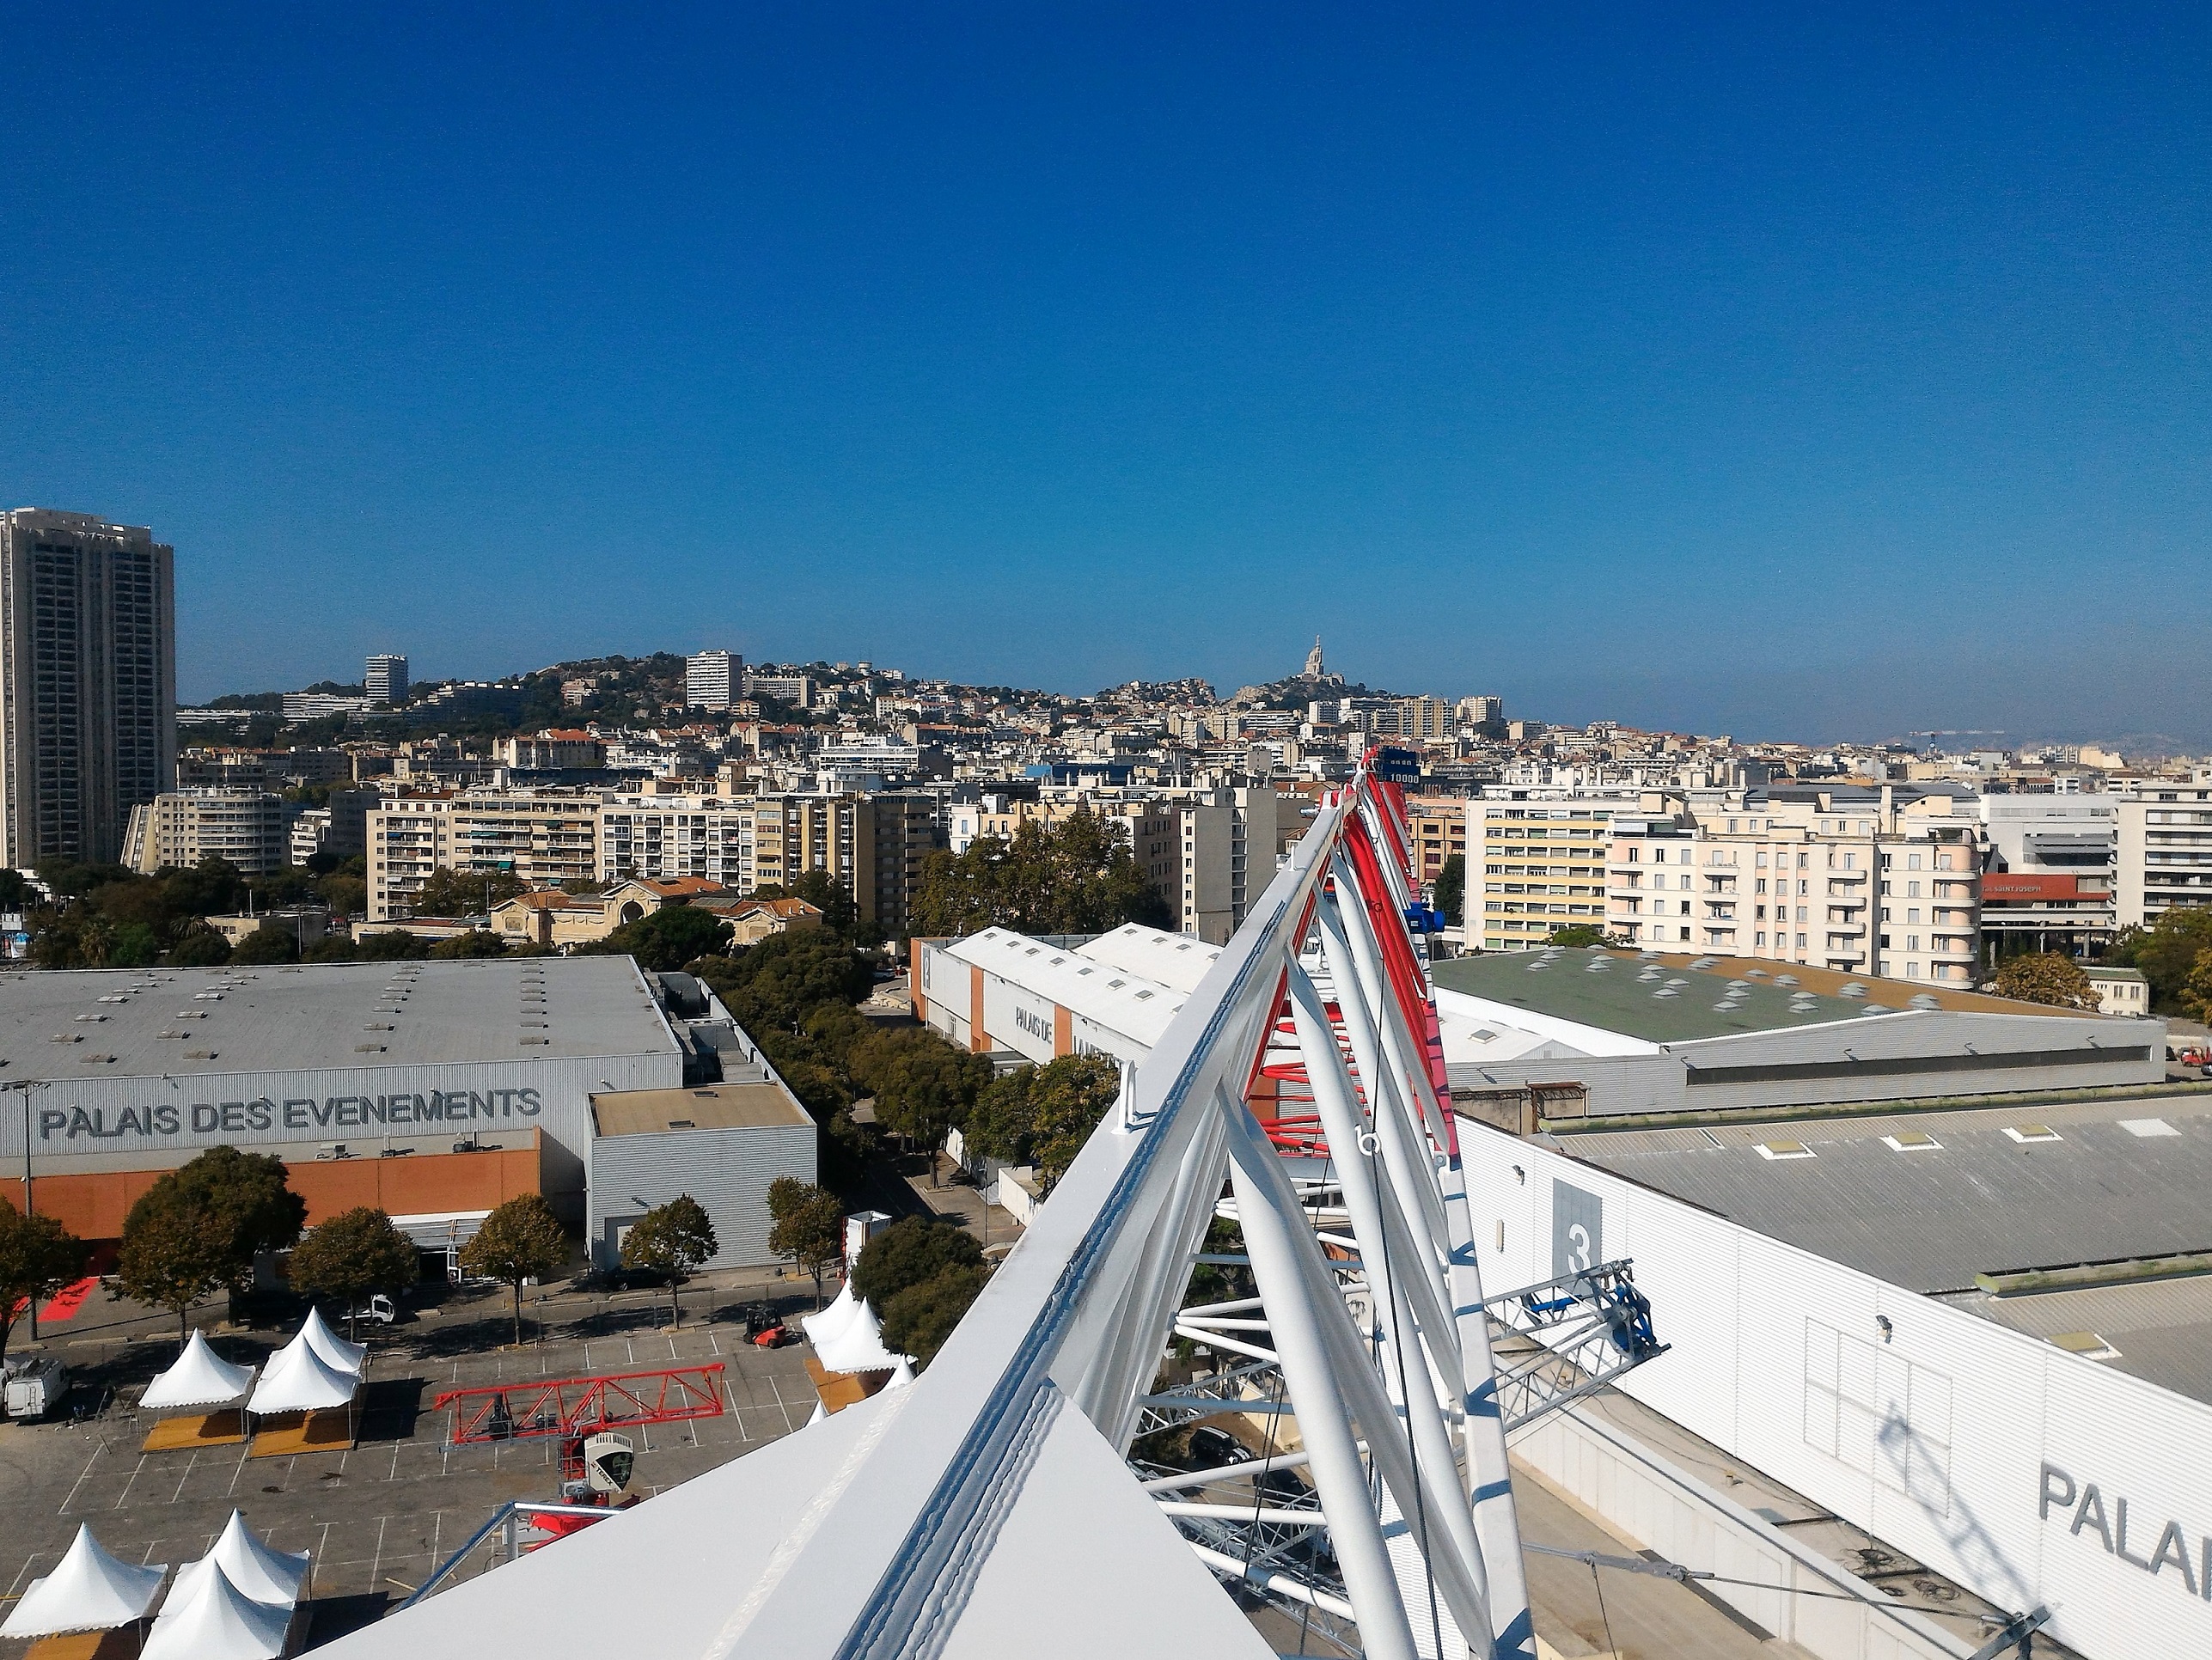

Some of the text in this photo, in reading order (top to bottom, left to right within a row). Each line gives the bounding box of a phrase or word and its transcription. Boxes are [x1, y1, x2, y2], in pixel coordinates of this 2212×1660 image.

[1390, 773, 1420, 784] 10000
[1016, 1005, 1041, 1038] PALAIS
[39, 1087, 542, 1140] PALAIS DES EVENEMENTS
[1567, 1223, 1592, 1274] 3
[596, 1467, 614, 1486] TEREX
